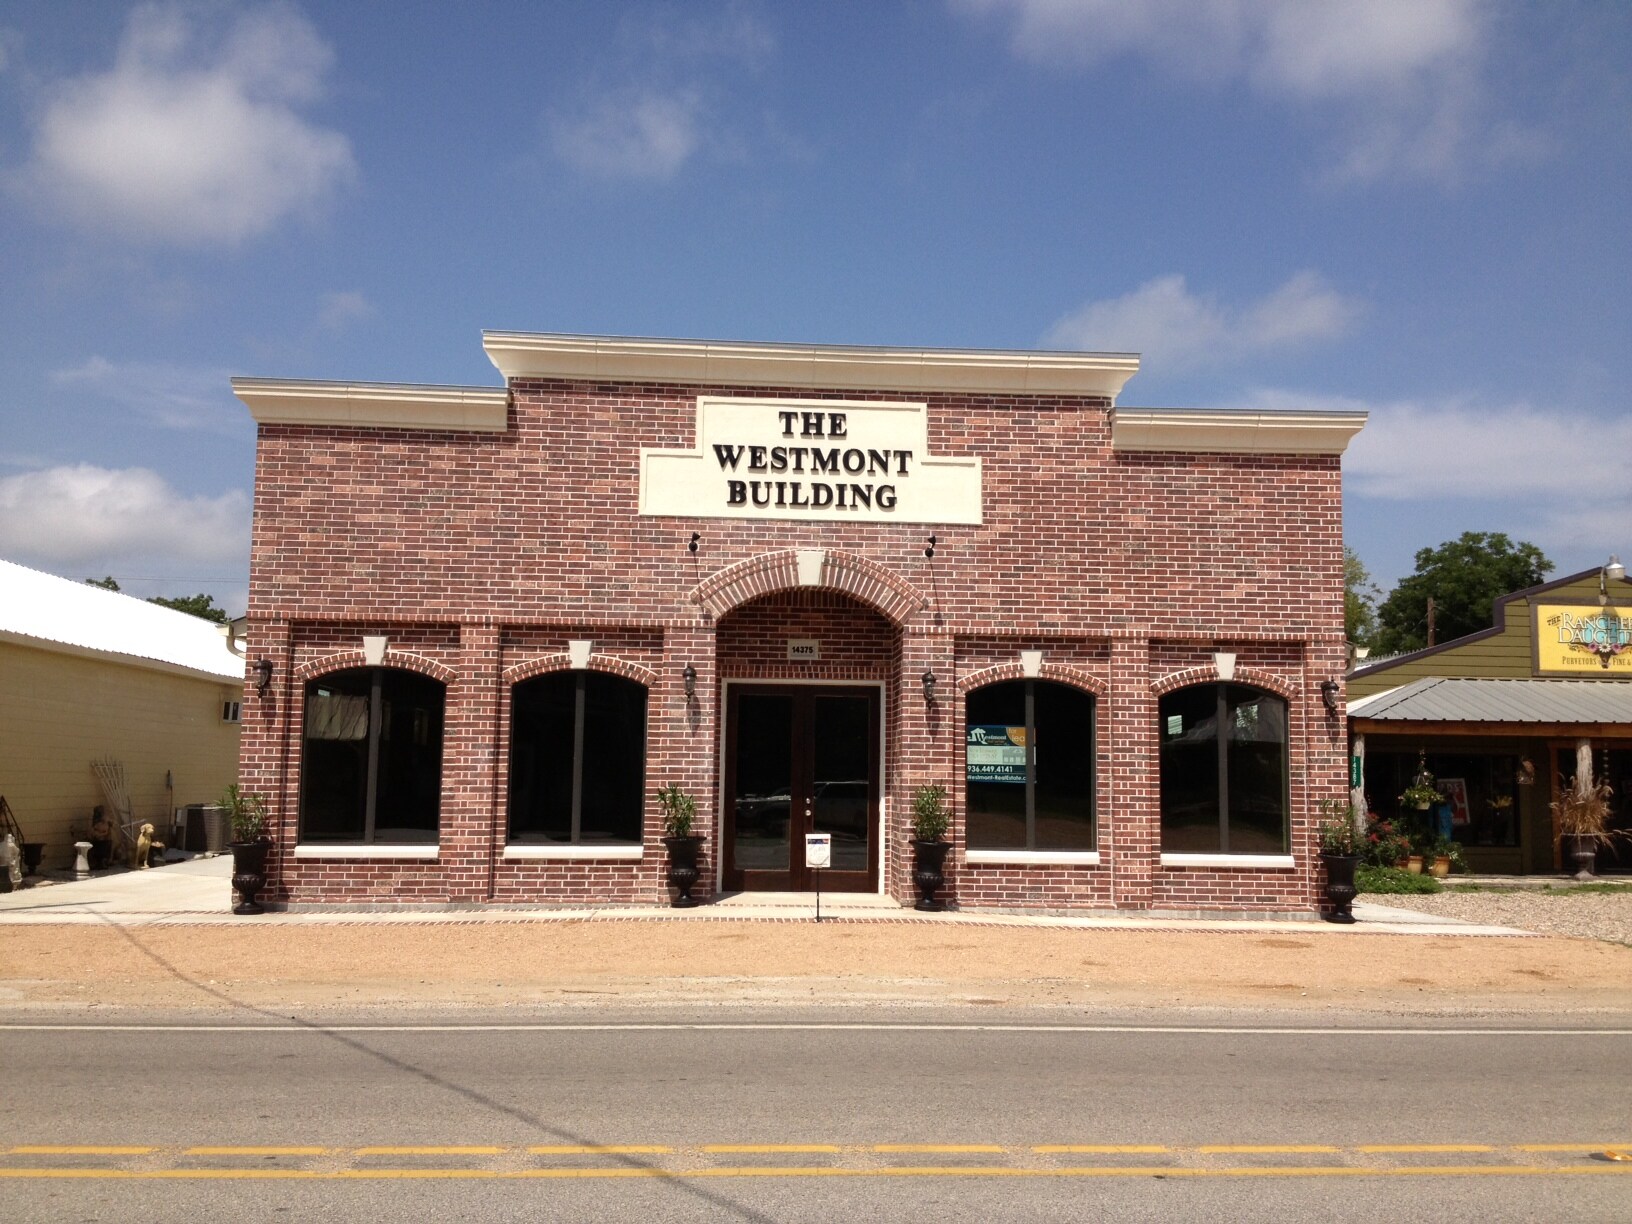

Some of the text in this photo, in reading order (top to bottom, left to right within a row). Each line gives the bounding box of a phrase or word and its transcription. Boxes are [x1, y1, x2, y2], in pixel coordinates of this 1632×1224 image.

[778, 410, 848, 437] THE
[712, 444, 913, 474] WESTMONT
[727, 480, 897, 510] BUILDING
[1547, 615, 1561, 626] THE
[1562, 656, 1597, 665] PURVEYORS
